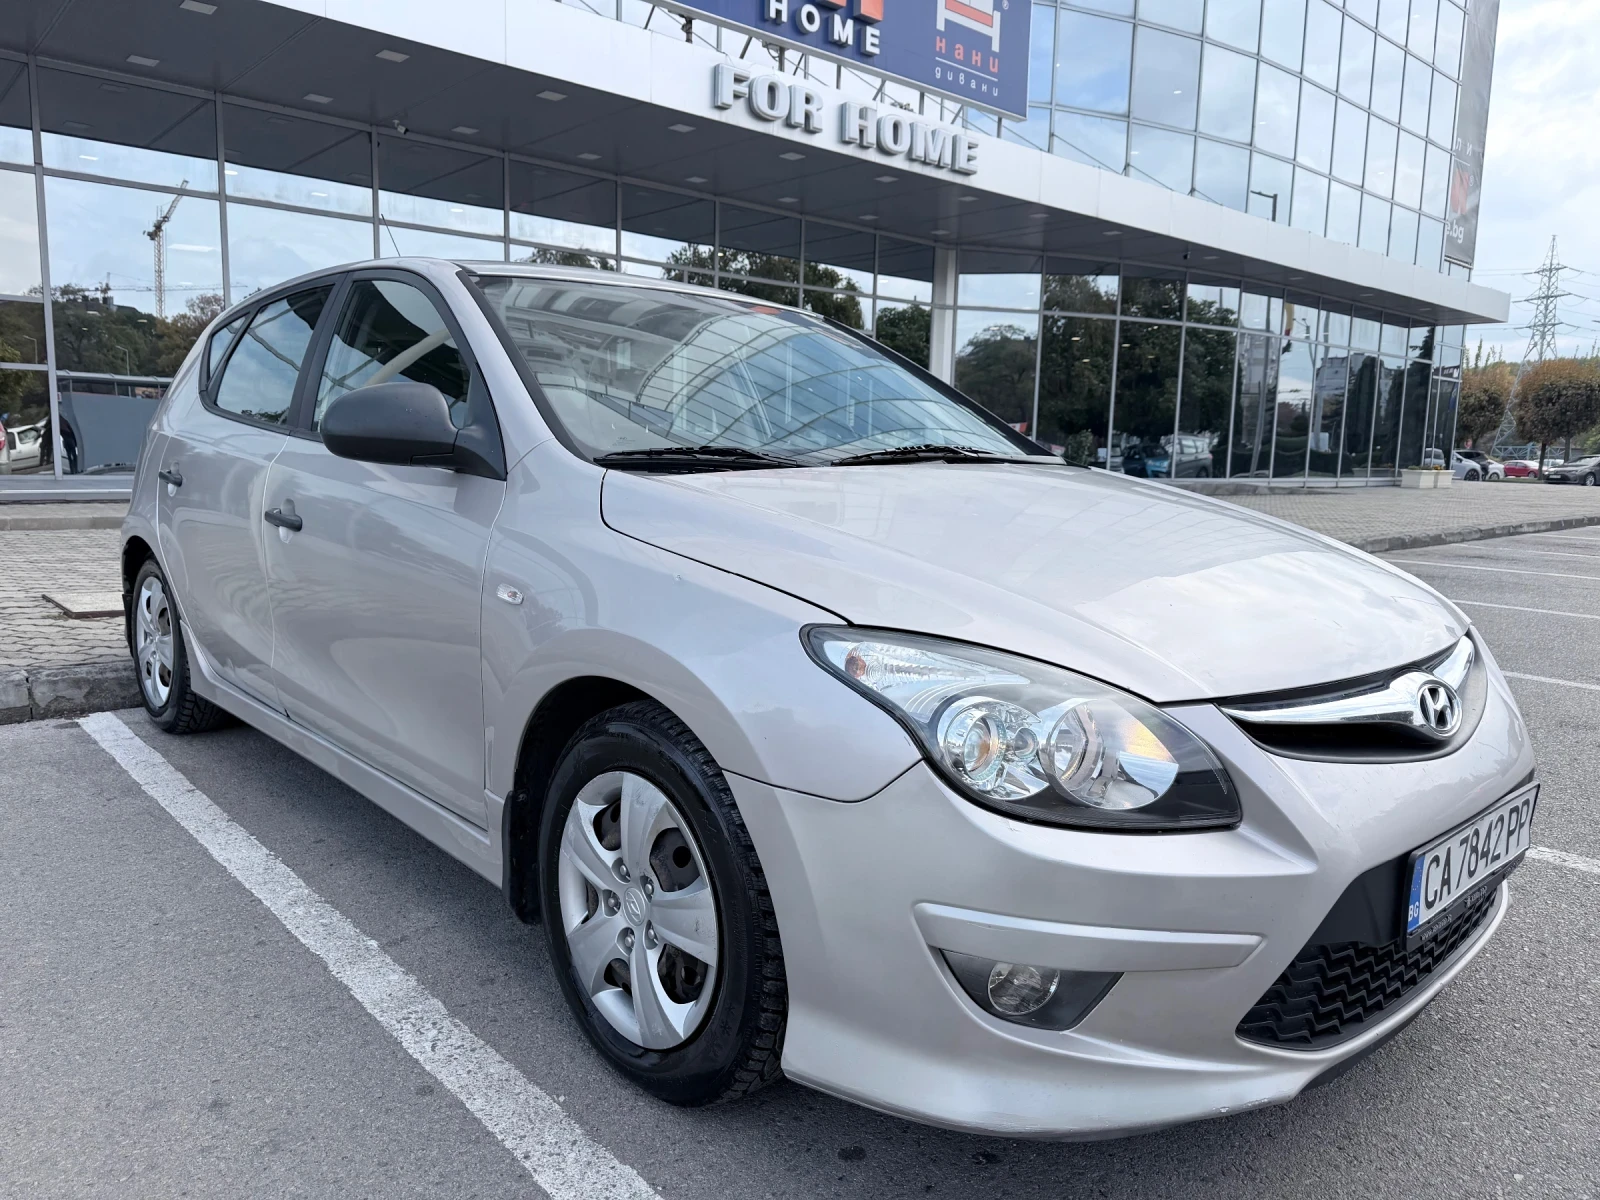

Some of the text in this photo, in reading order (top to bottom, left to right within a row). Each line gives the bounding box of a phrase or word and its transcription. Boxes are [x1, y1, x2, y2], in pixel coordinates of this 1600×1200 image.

[765, 0, 881, 56] HOME
[714, 63, 979, 175] FOR HOME
[1424, 798, 1531, 910] CA 7842 PP
[1408, 901, 1419, 921] BG
